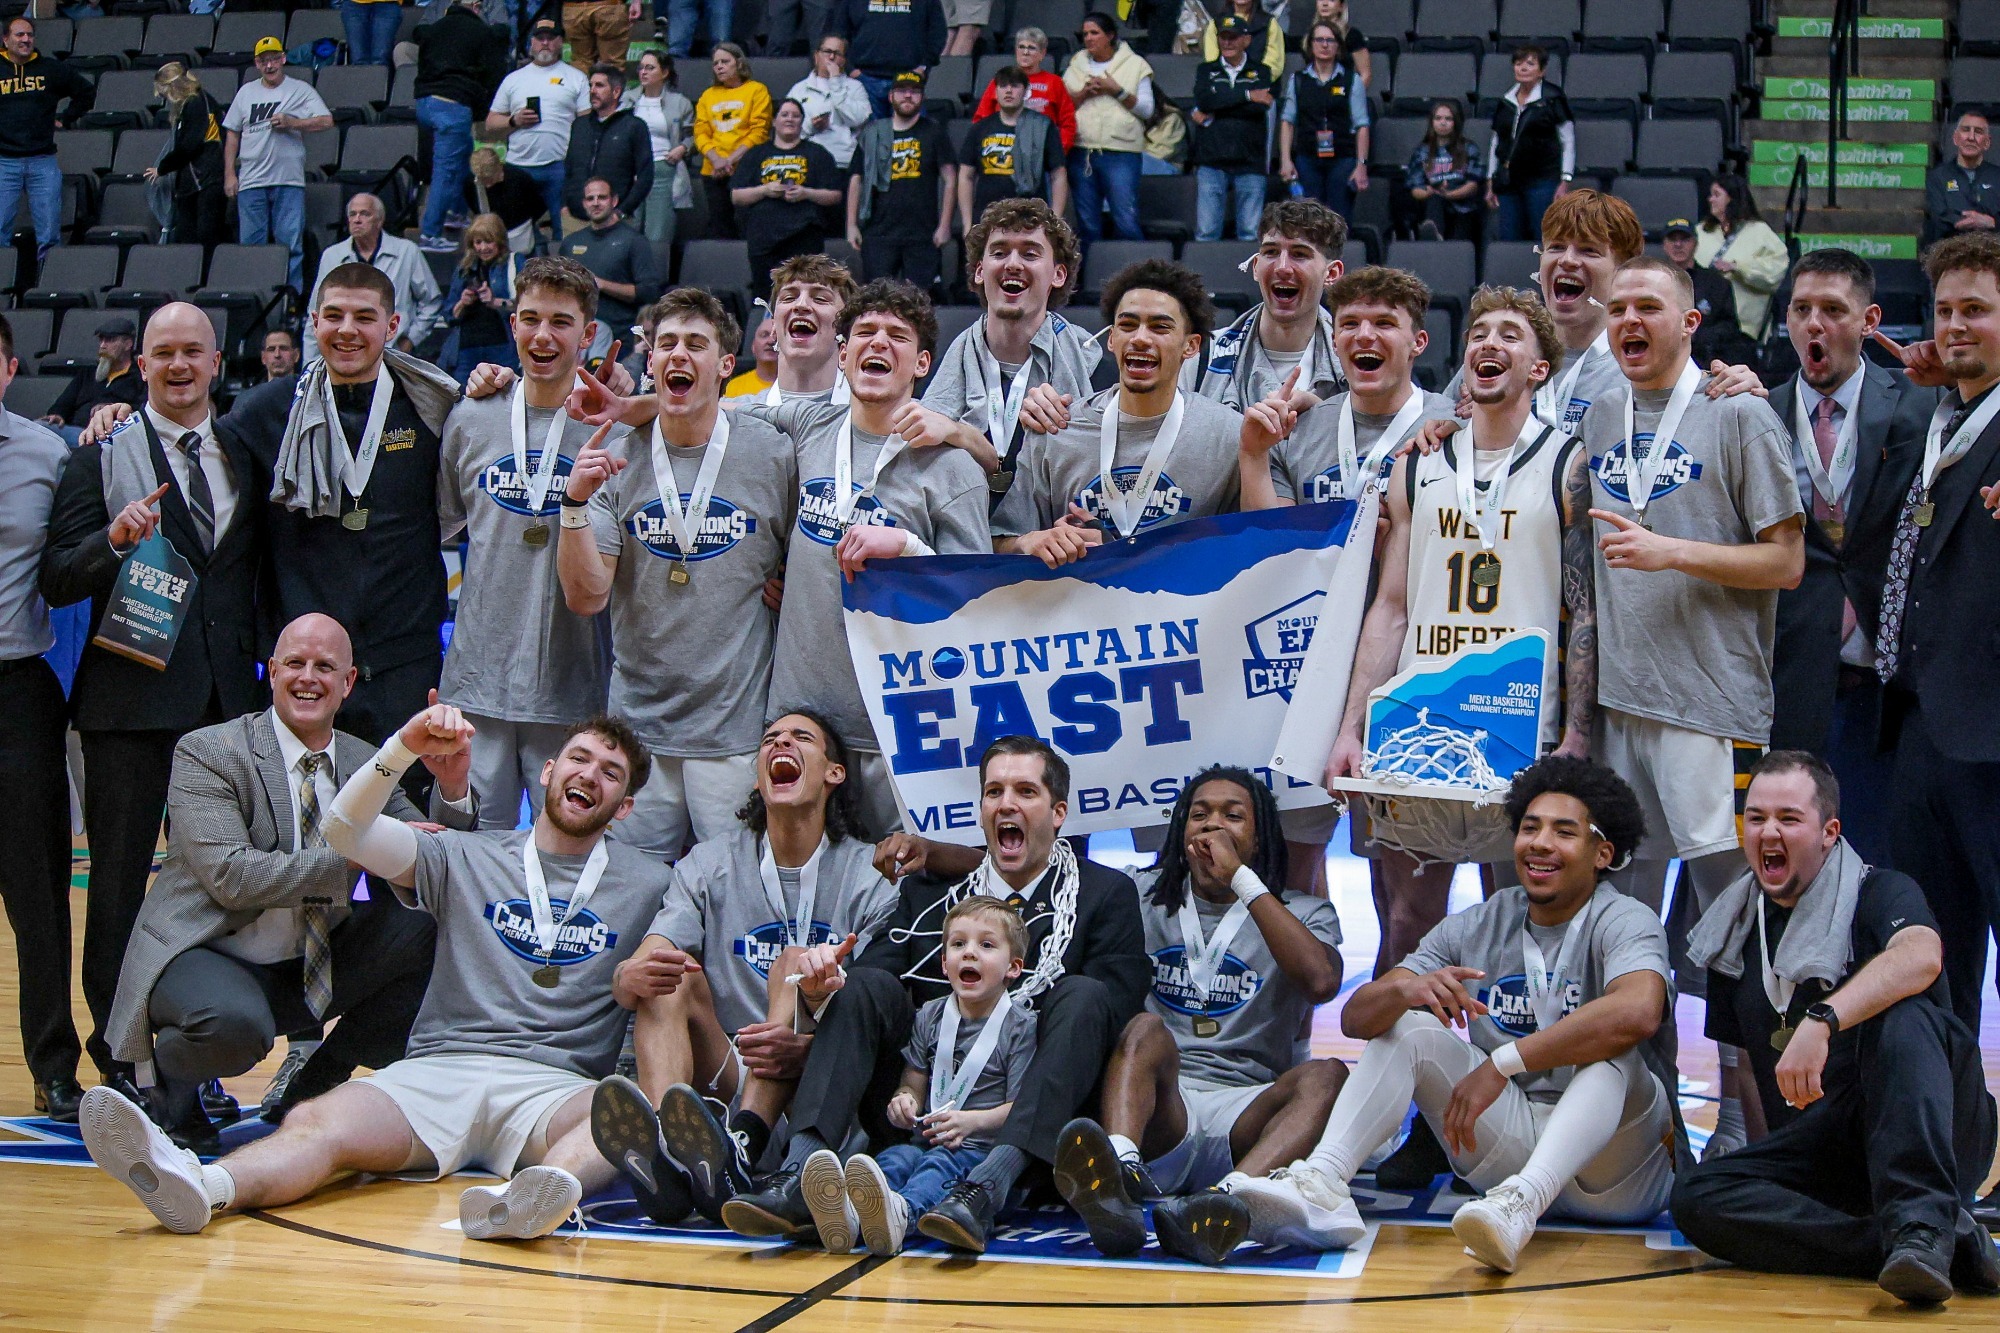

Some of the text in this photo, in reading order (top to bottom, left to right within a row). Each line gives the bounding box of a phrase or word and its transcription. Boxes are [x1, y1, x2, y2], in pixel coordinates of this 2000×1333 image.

[1821, 22, 1921, 38] ThealthPlan
[0, 75, 46, 95] WLSC
[1809, 82, 1912, 100] TheealthPlan
[1806, 104, 1909, 121] TheealthPlan
[633, 510, 747, 540] CHAIONS
[1438, 507, 1518, 541] WET
[1446, 551, 1502, 616] 10
[1416, 624, 1520, 656] LIBERT
[879, 618, 1199, 690] MOUNTAIN
[1507, 682, 1539, 699] 2026
[1459, 703, 1536, 717] TOURNAMENT CHAMPION
[1469, 694, 1536, 709] MEN'S BASKETBALL
[882, 658, 1204, 775] EAST
[492, 901, 609, 954] CHAIONS
[1181, 988, 1239, 1004] BASTBALL
